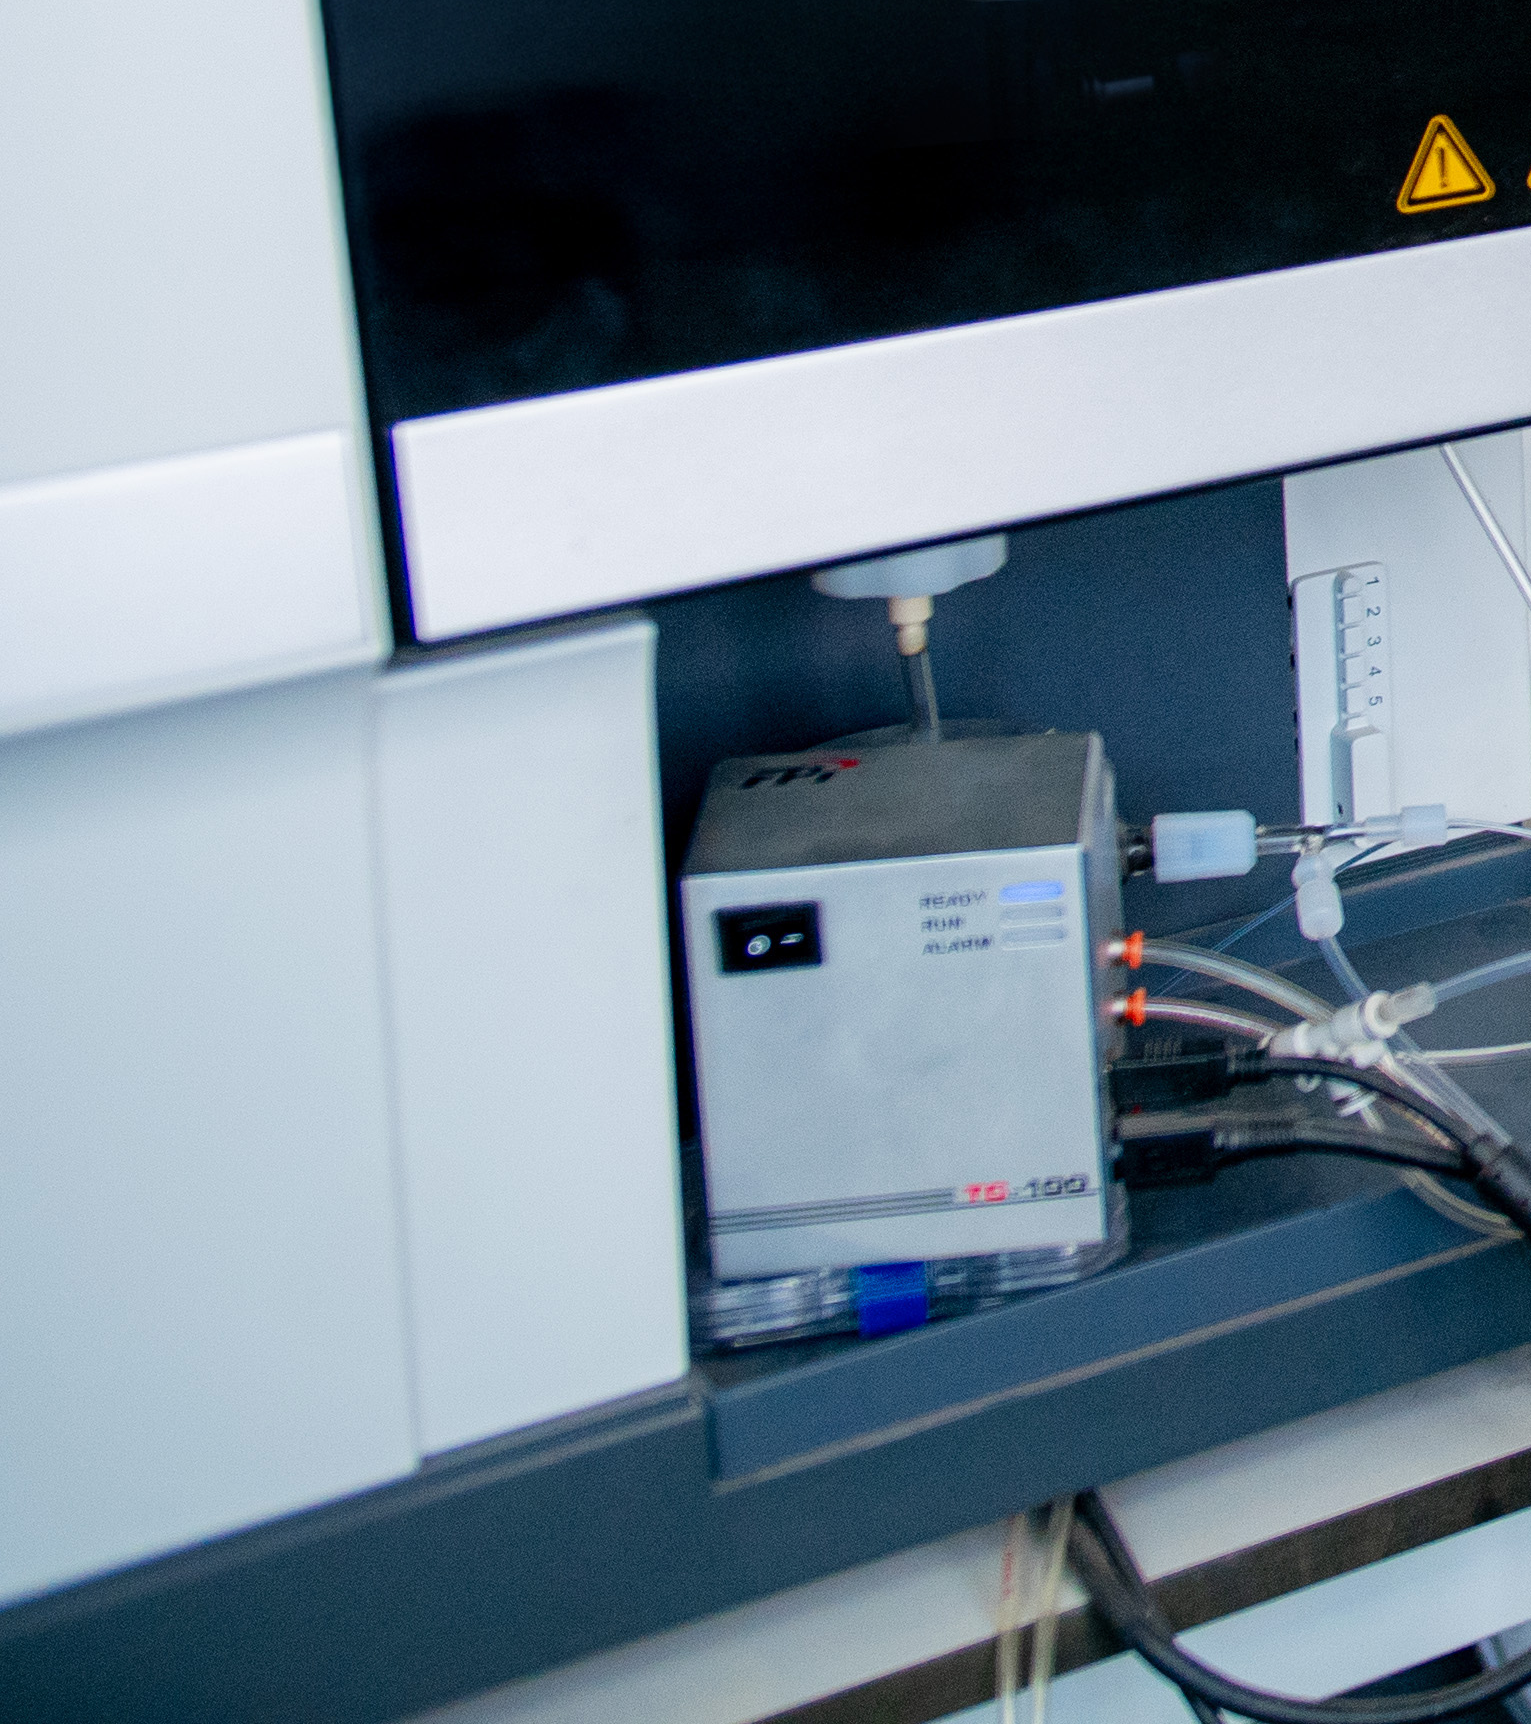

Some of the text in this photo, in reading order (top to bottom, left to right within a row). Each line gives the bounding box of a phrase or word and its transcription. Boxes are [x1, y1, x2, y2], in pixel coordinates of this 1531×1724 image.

[1366, 577, 1379, 585] 1
[1366, 606, 1380, 617] 2
[1367, 636, 1381, 646] 3
[1369, 666, 1382, 676] 4
[1369, 696, 1382, 706] 5
[919, 891, 986, 909] READY
